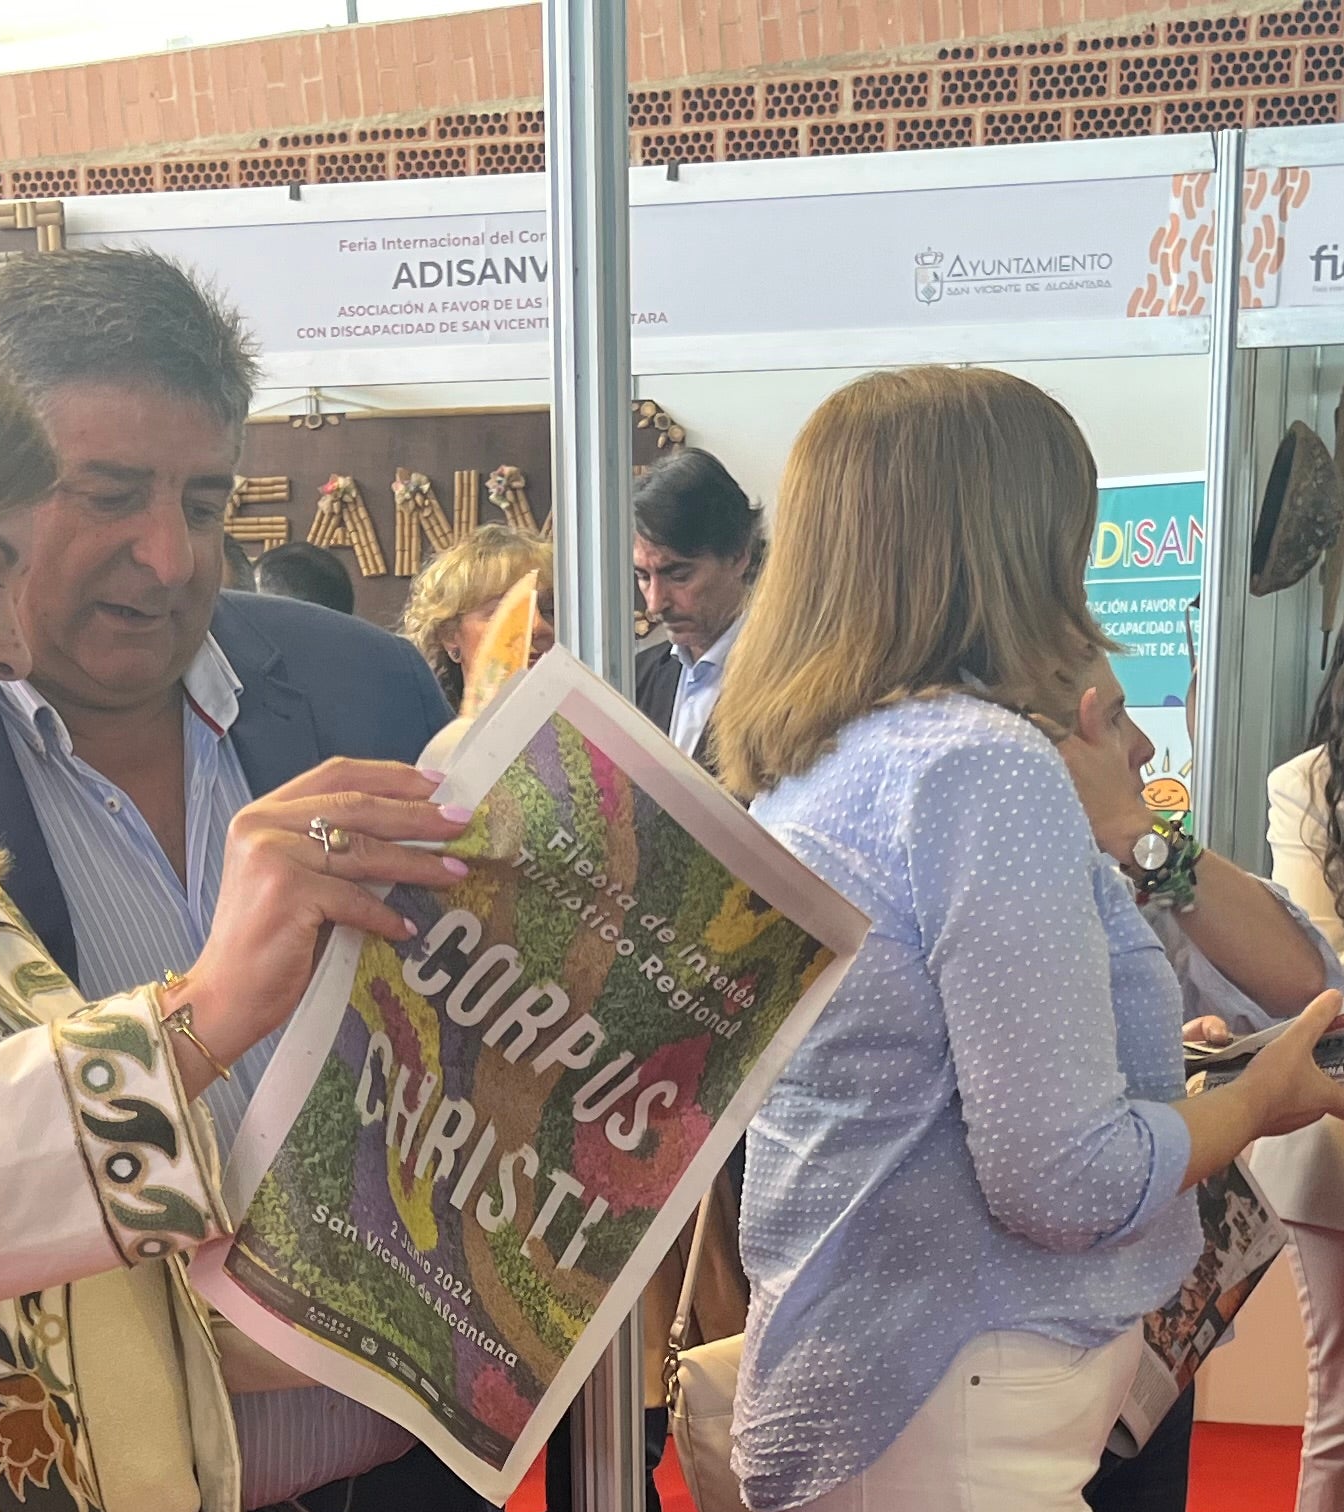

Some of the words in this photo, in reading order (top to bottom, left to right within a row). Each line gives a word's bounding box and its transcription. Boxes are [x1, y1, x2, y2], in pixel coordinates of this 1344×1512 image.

[339, 238, 377, 252] Feria
[382, 233, 484, 250] Internacional
[489, 231, 513, 245] del
[392, 256, 548, 290] ADISANV
[297, 327, 327, 339] CON
[330, 323, 436, 338] DISCAPACIDAD
[440, 322, 457, 333] DE
[462, 320, 490, 331] SAN
[337, 303, 424, 317] ASOCIACIÓN
[428, 303, 438, 313] A
[442, 299, 490, 312] FAVOR
[494, 299, 512, 310] DE
[516, 298, 542, 309] LAS
[1130, 600, 1138, 612] A
[1141, 598, 1176, 613] FAVOR
[512, 846, 634, 956] Turístico
[639, 953, 743, 1040] Regional
[547, 826, 638, 912] Fiesta
[640, 914, 676, 943] de
[678, 944, 755, 1009] Interés
[402, 909, 678, 1152] CORPUS
[356, 1031, 610, 1270] CHRISTI
[312, 1205, 358, 1243] San
[366, 1231, 416, 1288] Vicente
[418, 1284, 431, 1304] de
[434, 1297, 518, 1368] Alcántara
[391, 1220, 399, 1239] 2
[401, 1234, 431, 1274] Junio
[435, 1267, 472, 1305] 2024
